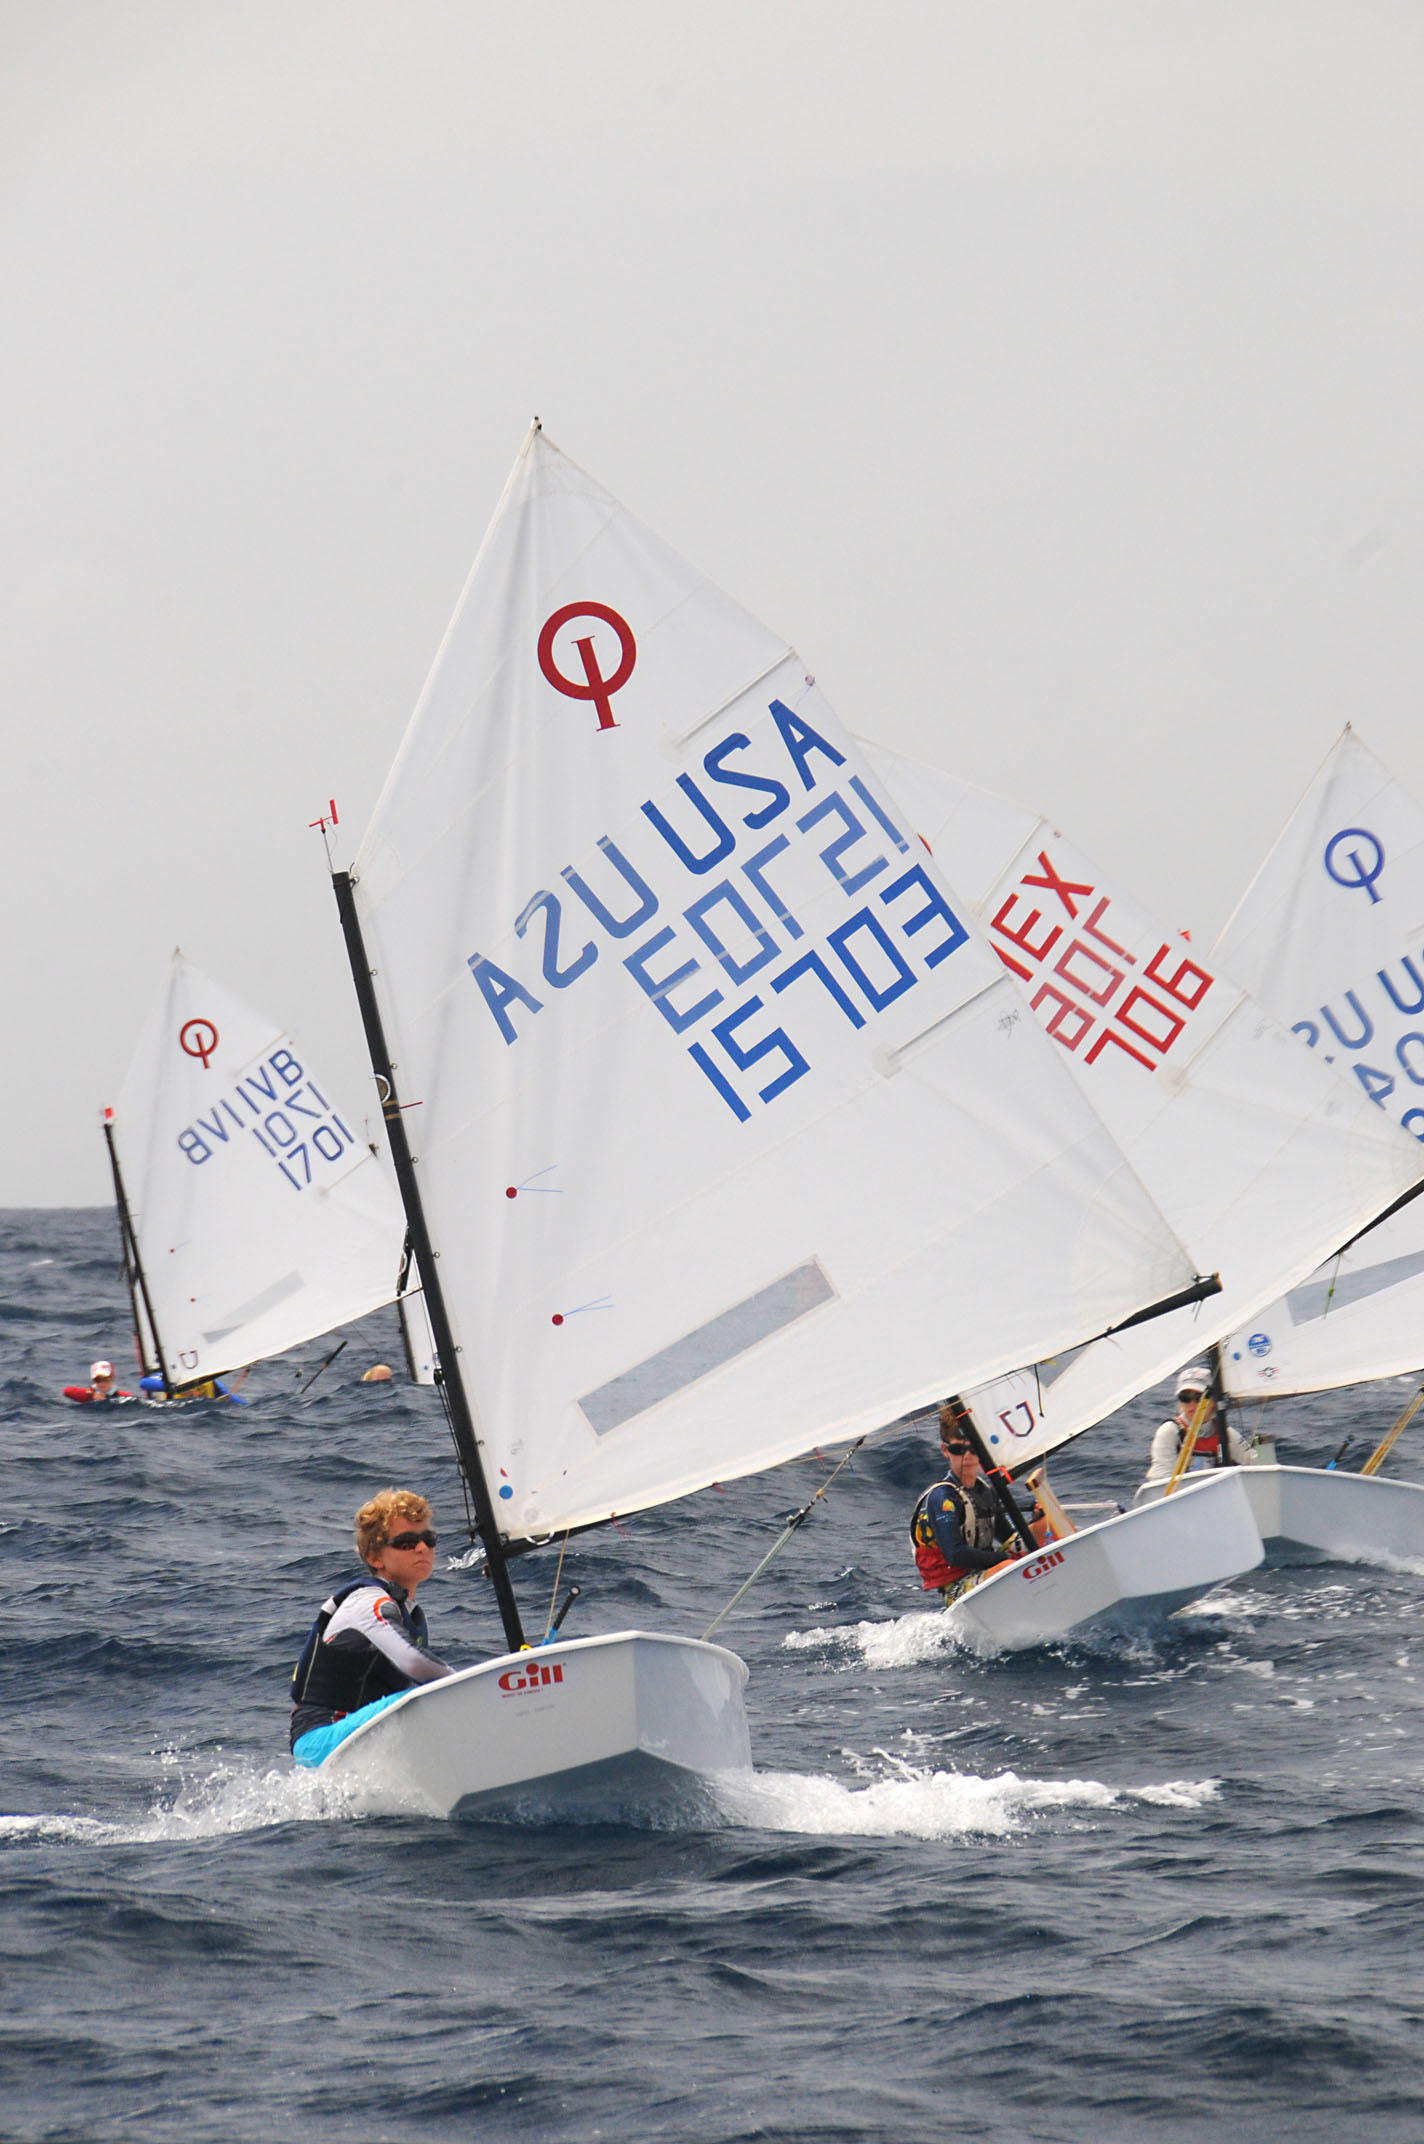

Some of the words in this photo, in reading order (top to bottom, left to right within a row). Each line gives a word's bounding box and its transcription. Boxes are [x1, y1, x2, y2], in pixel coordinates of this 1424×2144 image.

[641, 699, 847, 876] USA
[687, 863, 970, 1123] 15703
[1083, 943, 1215, 1072] 706
[277, 1112, 355, 1191] 1701
[1022, 1551, 1065, 1579] Gill
[498, 1662, 564, 1691] Gill
